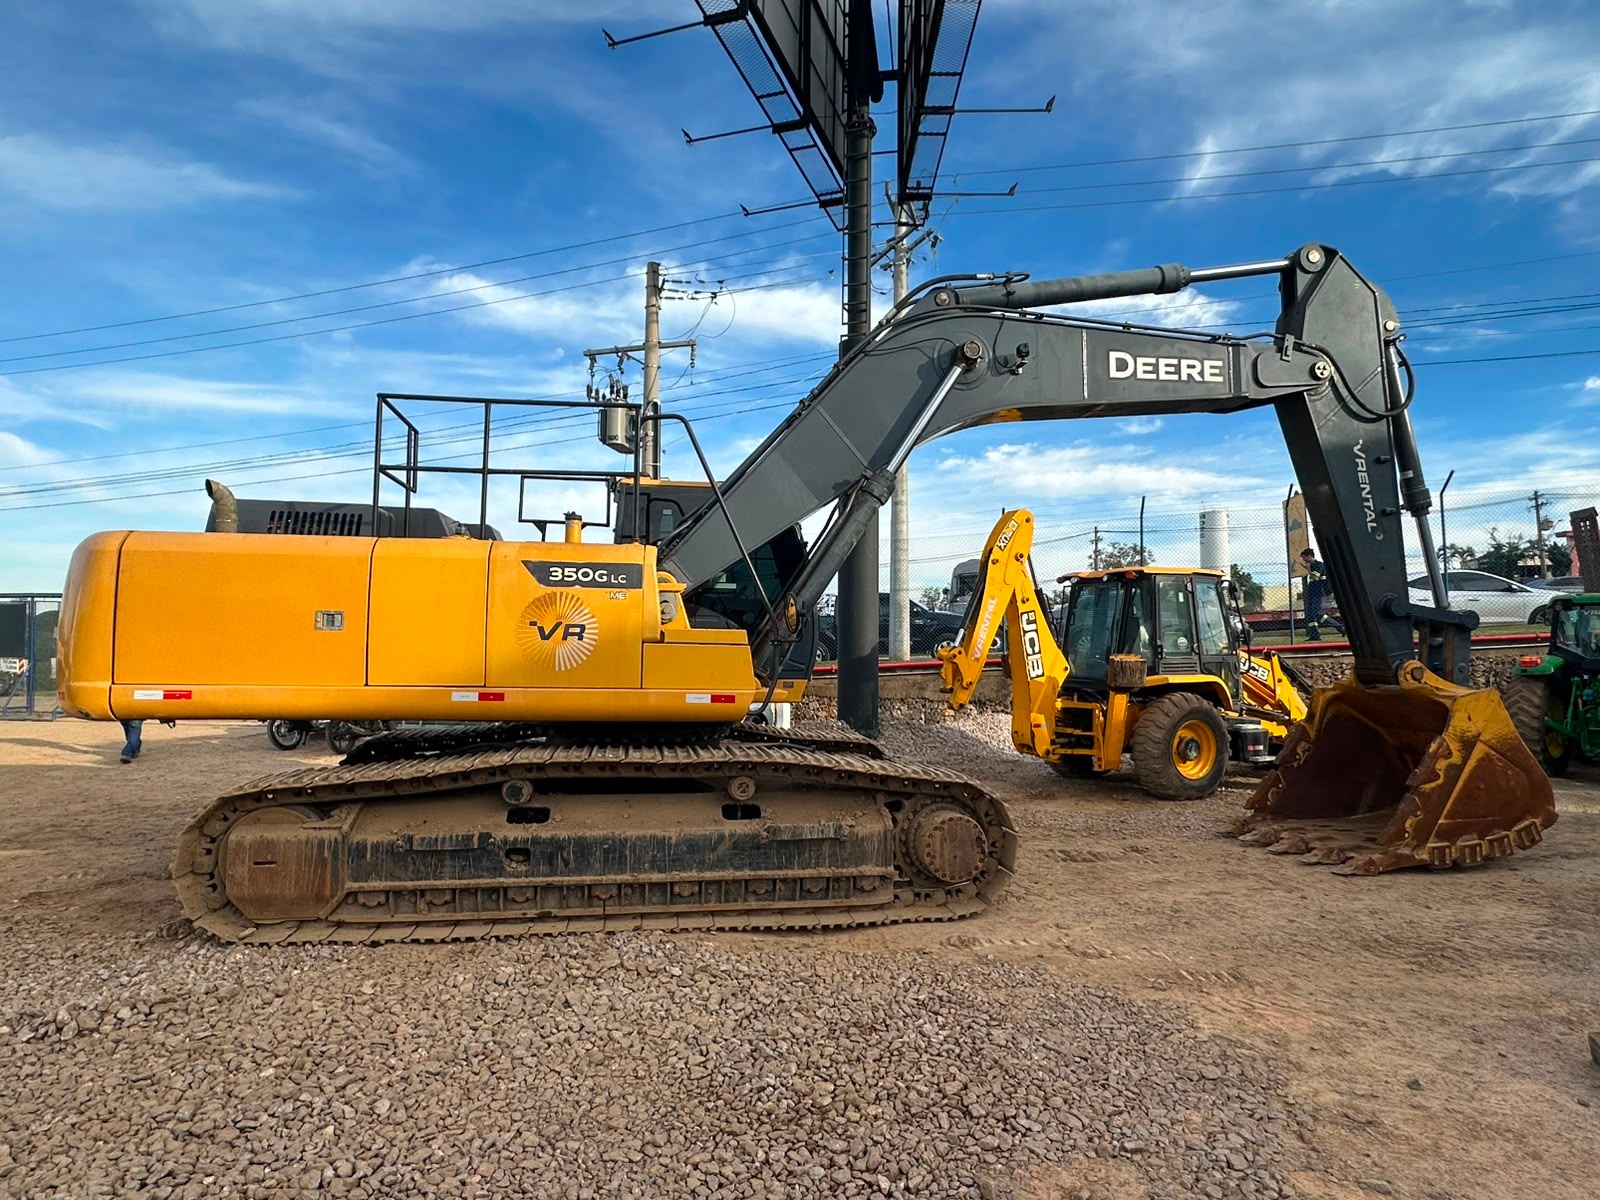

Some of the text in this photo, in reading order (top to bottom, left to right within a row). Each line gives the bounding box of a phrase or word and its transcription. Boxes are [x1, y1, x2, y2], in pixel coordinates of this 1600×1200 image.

[1108, 351, 1224, 382] DEERE
[1352, 439, 1377, 533] VRENTAL
[549, 566, 627, 584] 350G LC
[609, 591, 627, 600] ME
[528, 620, 586, 641] VR
[971, 597, 998, 660] VRENTAL
[1021, 611, 1044, 678] JCB
